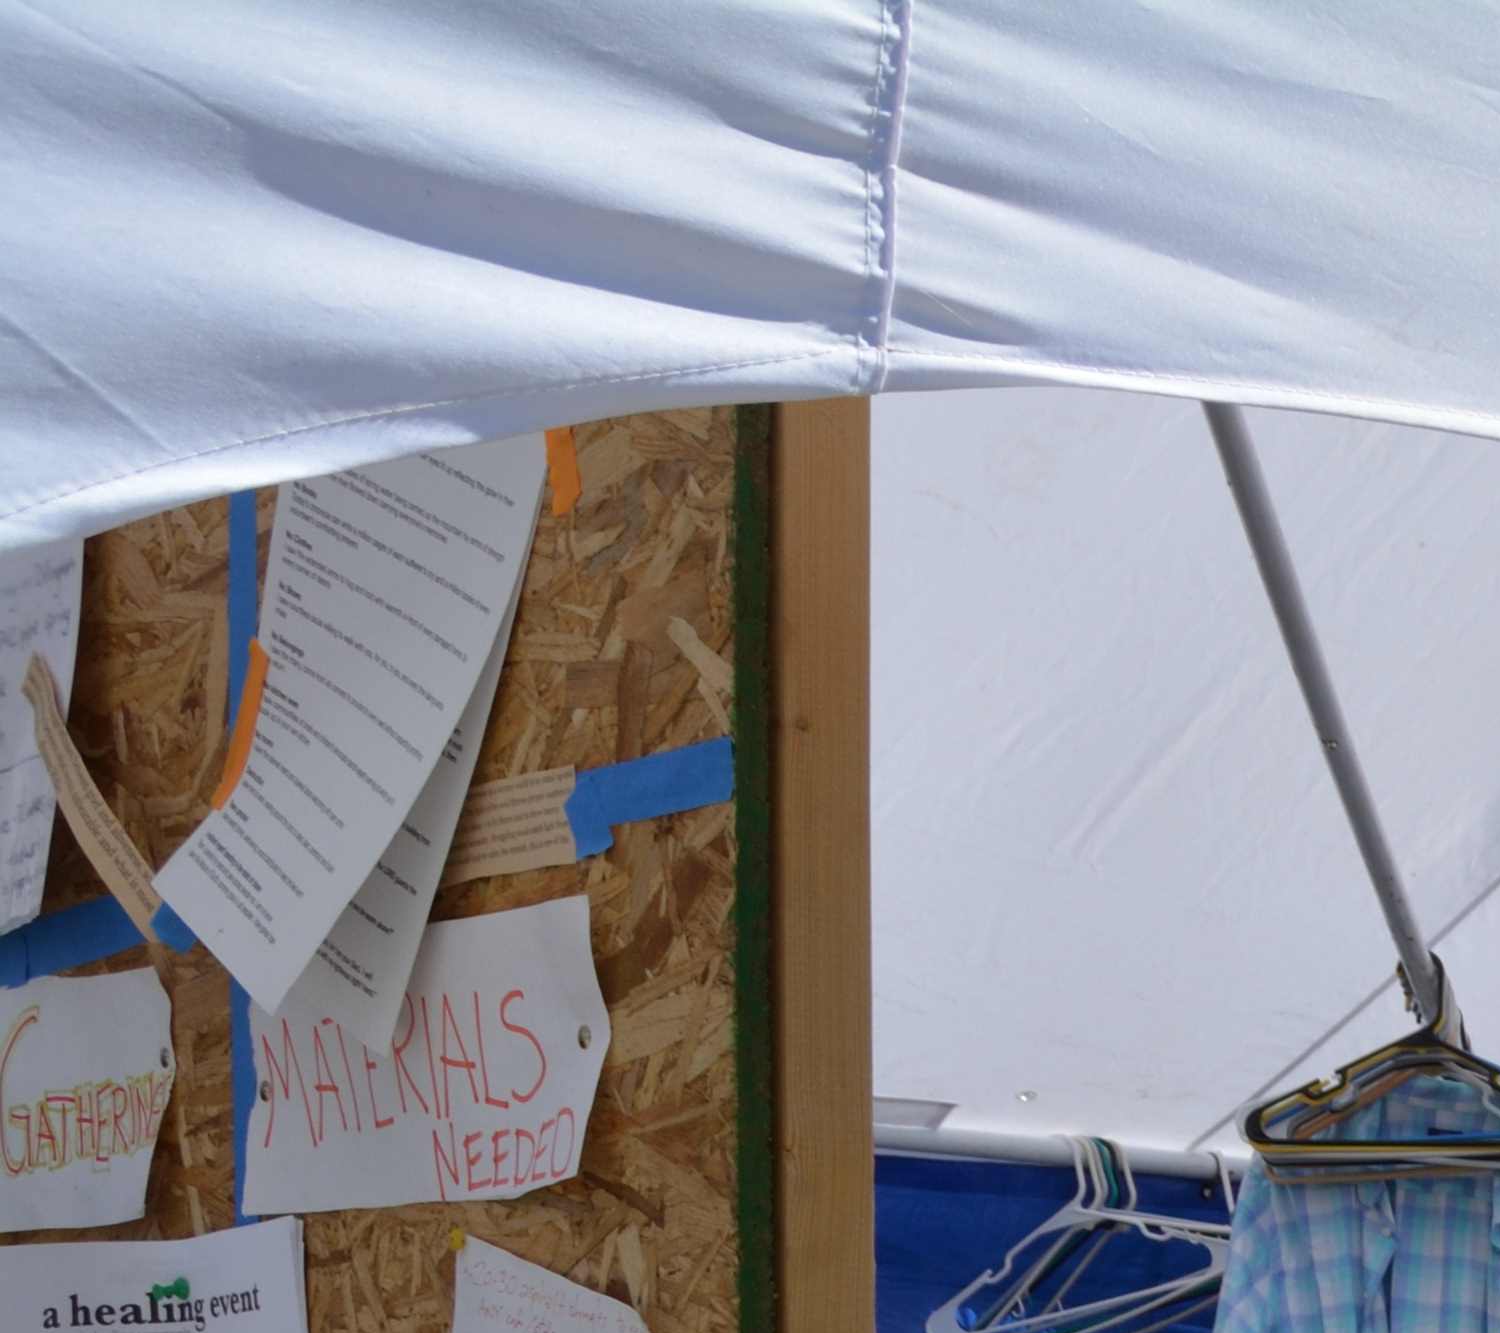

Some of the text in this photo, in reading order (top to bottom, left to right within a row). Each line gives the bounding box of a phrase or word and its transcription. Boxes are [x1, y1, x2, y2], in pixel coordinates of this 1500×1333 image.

[432, 1107, 576, 1200] NEEDED
[43, 1284, 261, 1332] a healing event
